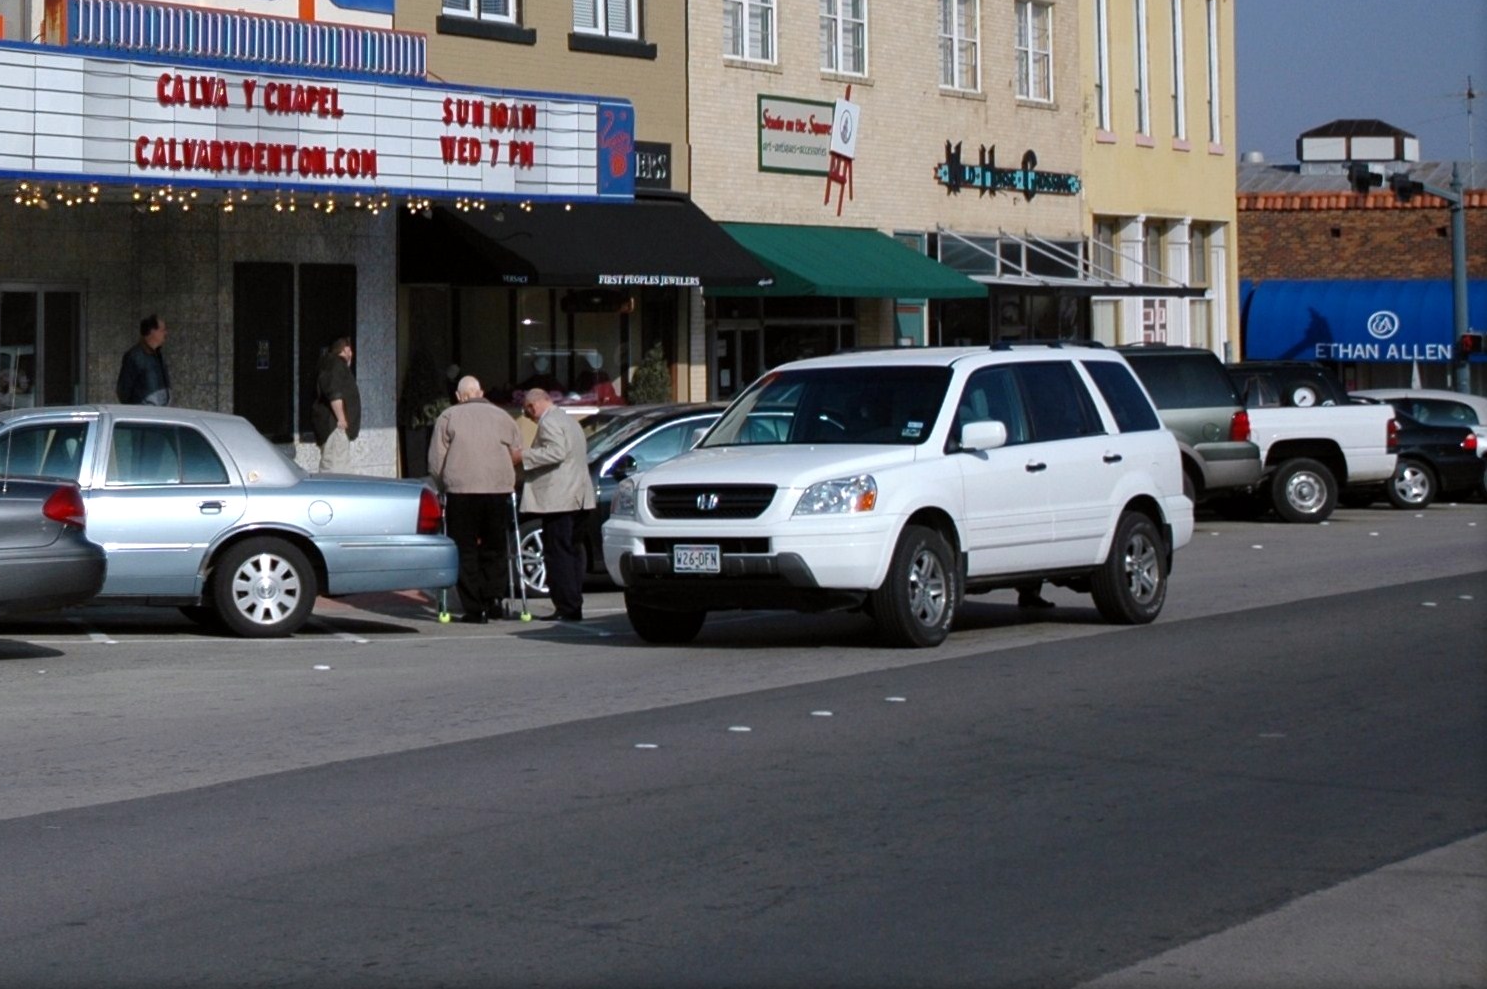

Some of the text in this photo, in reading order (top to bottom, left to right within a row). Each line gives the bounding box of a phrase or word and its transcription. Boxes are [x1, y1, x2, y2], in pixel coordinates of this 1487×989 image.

[263, 81, 345, 119] CHAPEL
[442, 97, 486, 130] SUN
[134, 135, 379, 179] CALVARYDENTON.COM
[439, 135, 535, 171] WED 7 PM
[598, 274, 700, 287] FIRST PEOPLES JEWELERS
[1315, 343, 1452, 361] ETHAN ALLEN
